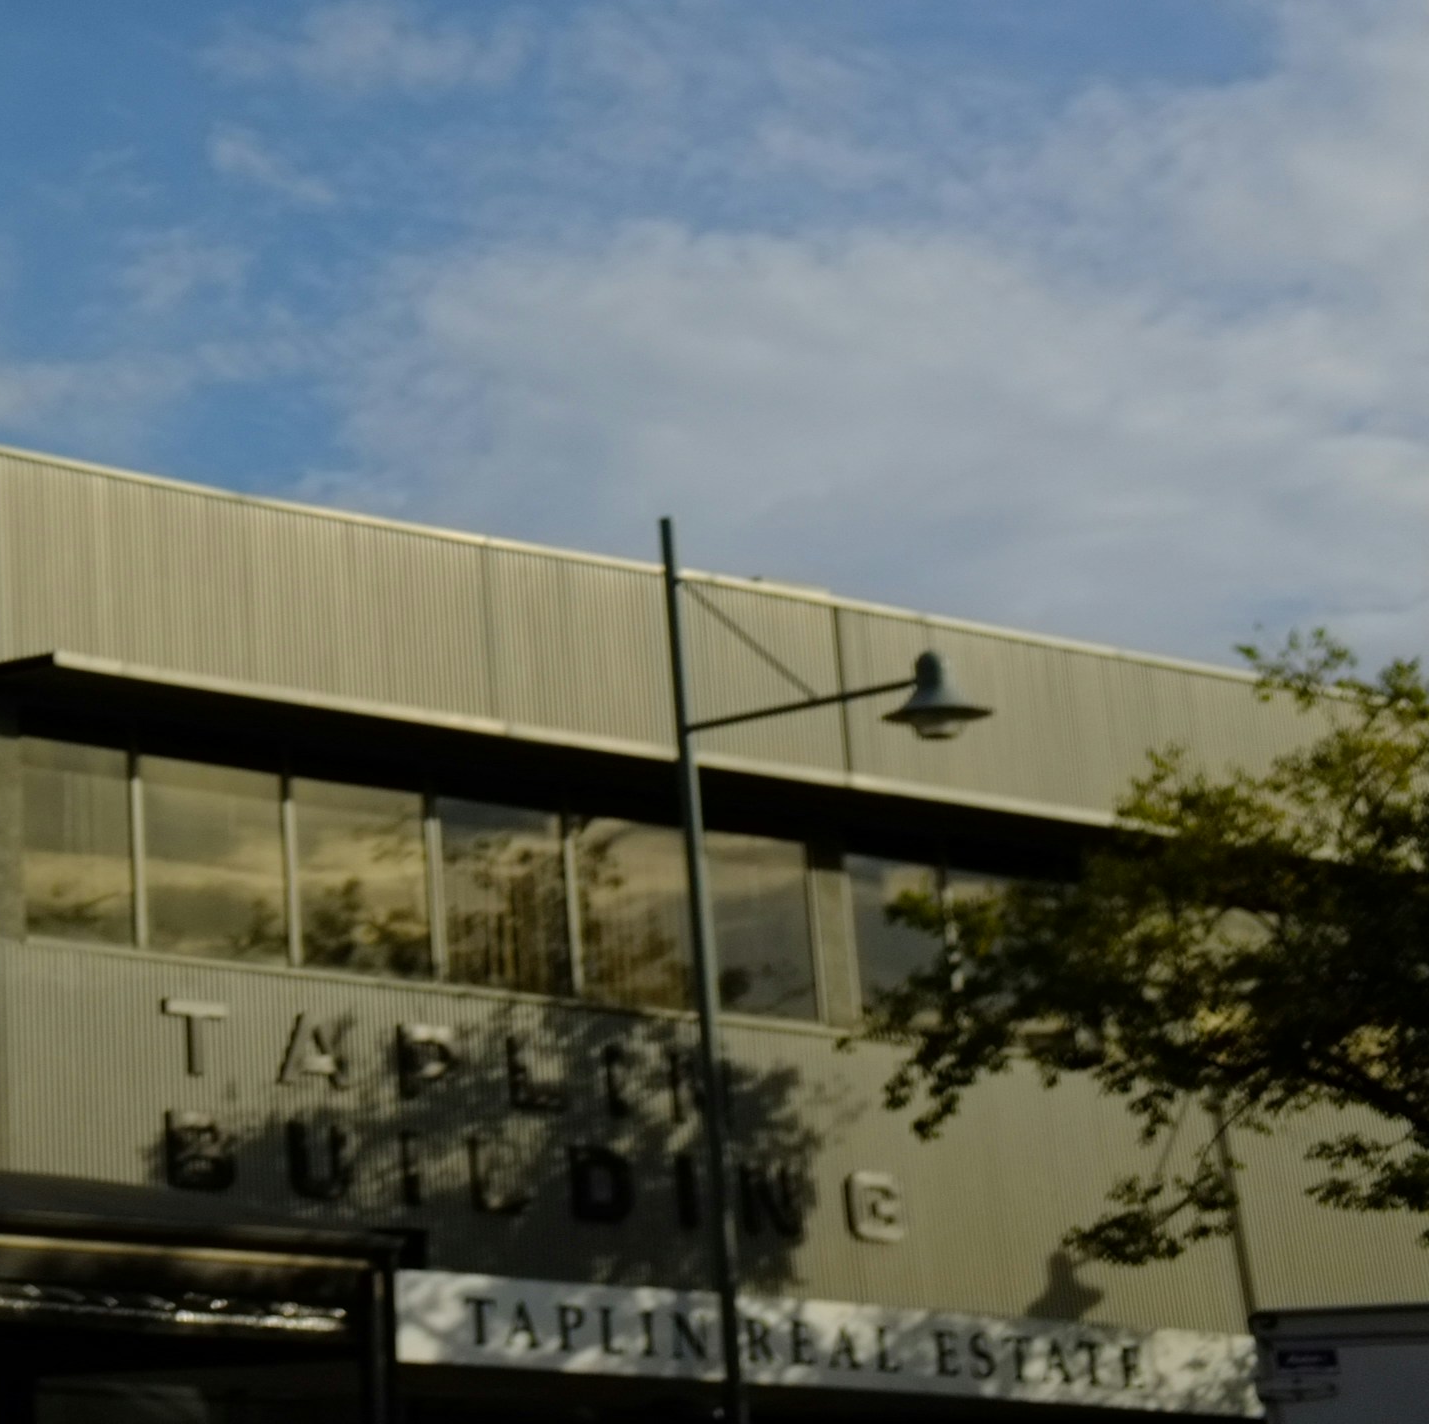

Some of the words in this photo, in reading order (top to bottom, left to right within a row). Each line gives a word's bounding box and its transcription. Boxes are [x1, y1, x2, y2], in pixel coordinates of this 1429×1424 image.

[164, 1108, 905, 1243] BUILDING
[464, 1296, 708, 1361] TAPLIN
[744, 1318, 902, 1375] REAL
[935, 1328, 1144, 1391] ESTATE
